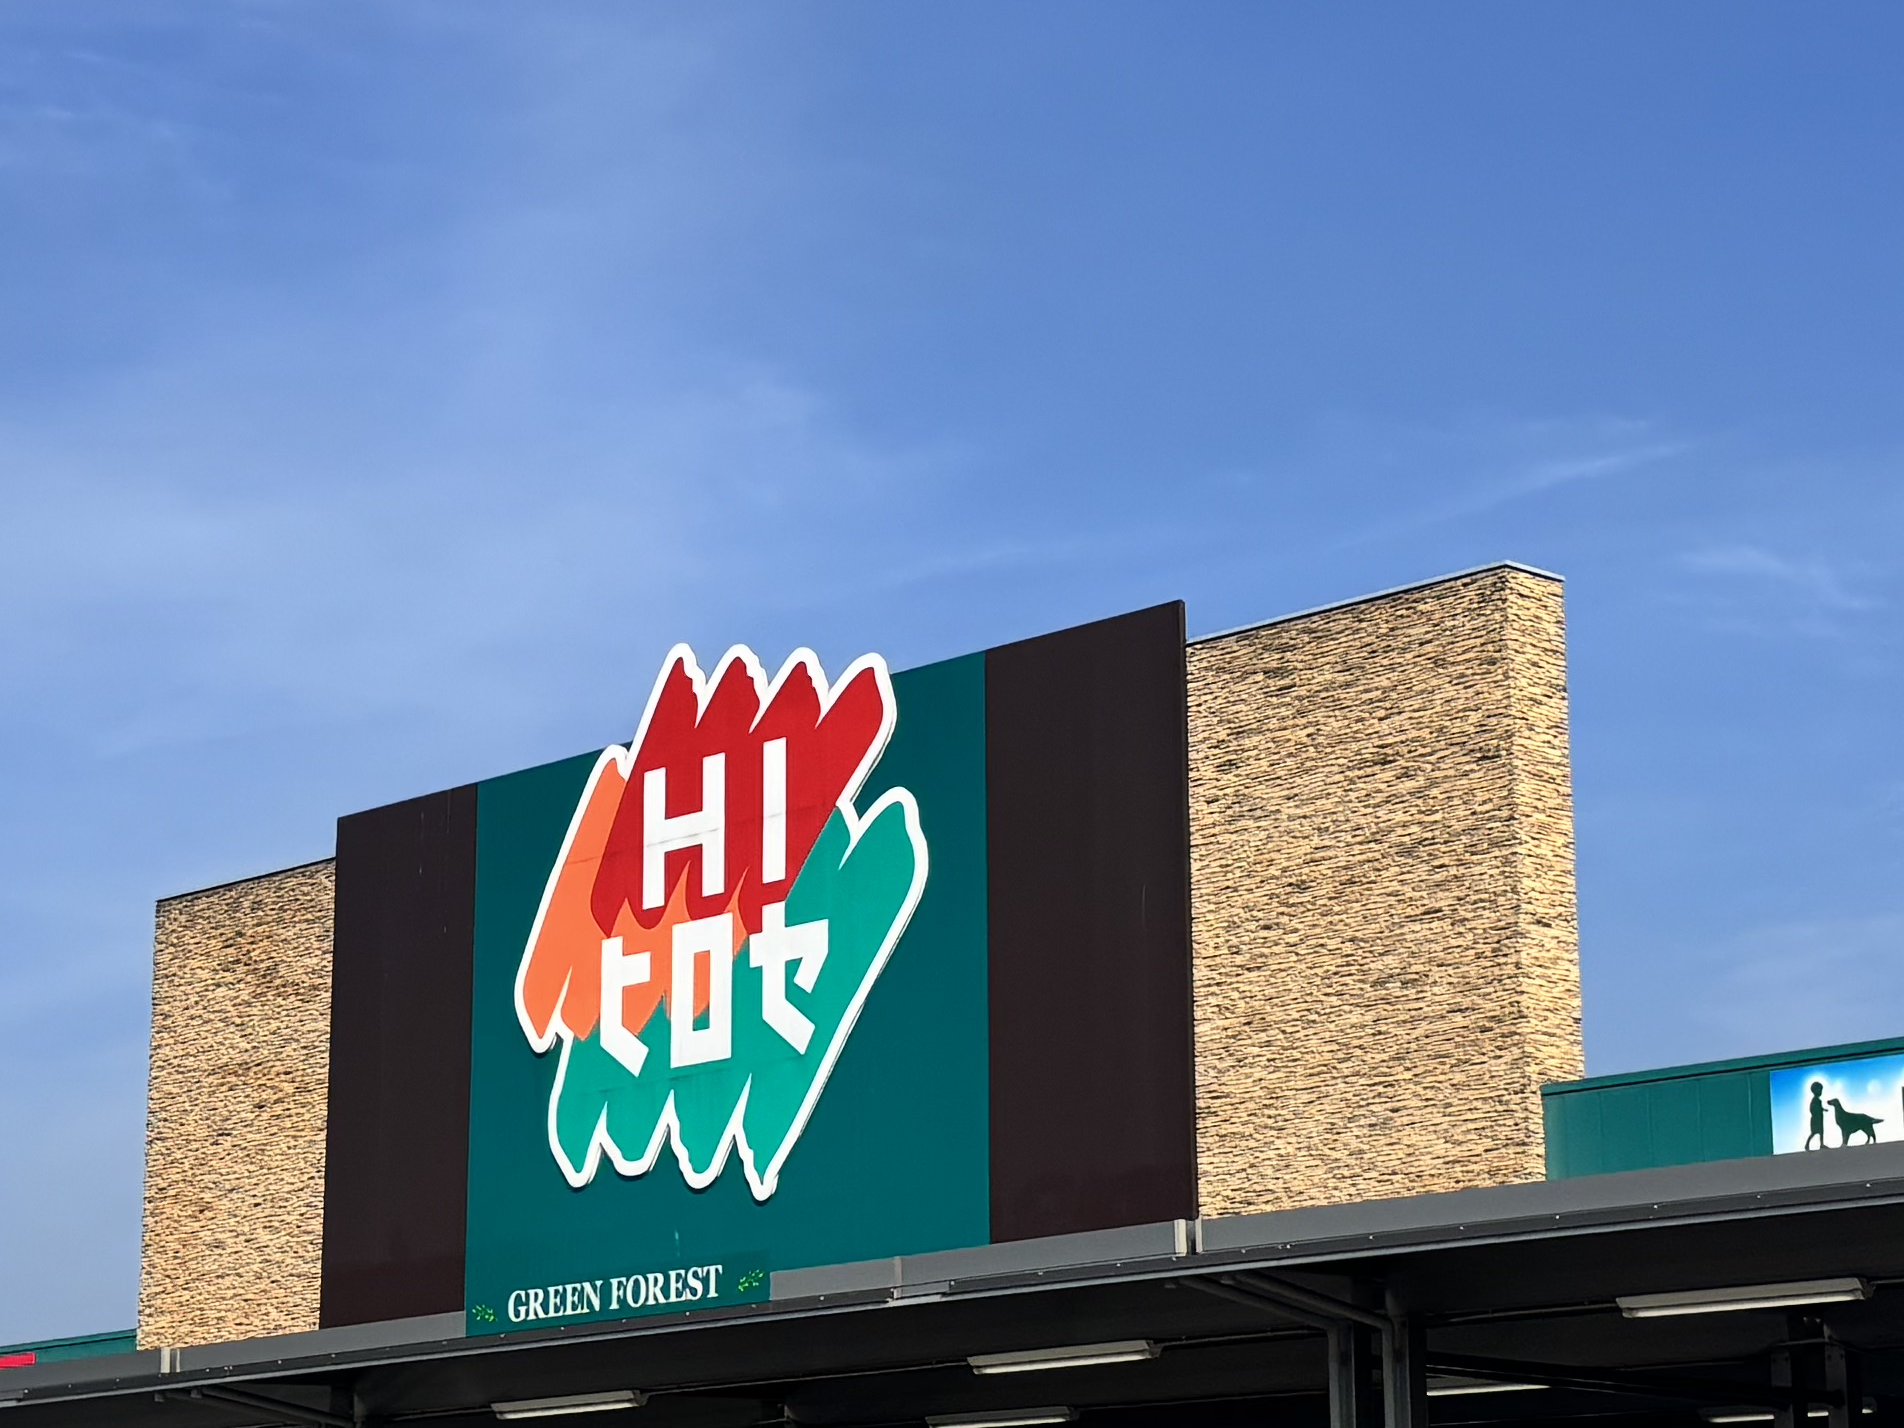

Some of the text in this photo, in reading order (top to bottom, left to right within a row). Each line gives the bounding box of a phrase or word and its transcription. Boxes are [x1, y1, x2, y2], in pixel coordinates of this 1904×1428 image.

[642, 737, 786, 910] HI
[600, 901, 828, 1076] ヒロセ
[508, 1264, 723, 1323] GREEN FOREST
